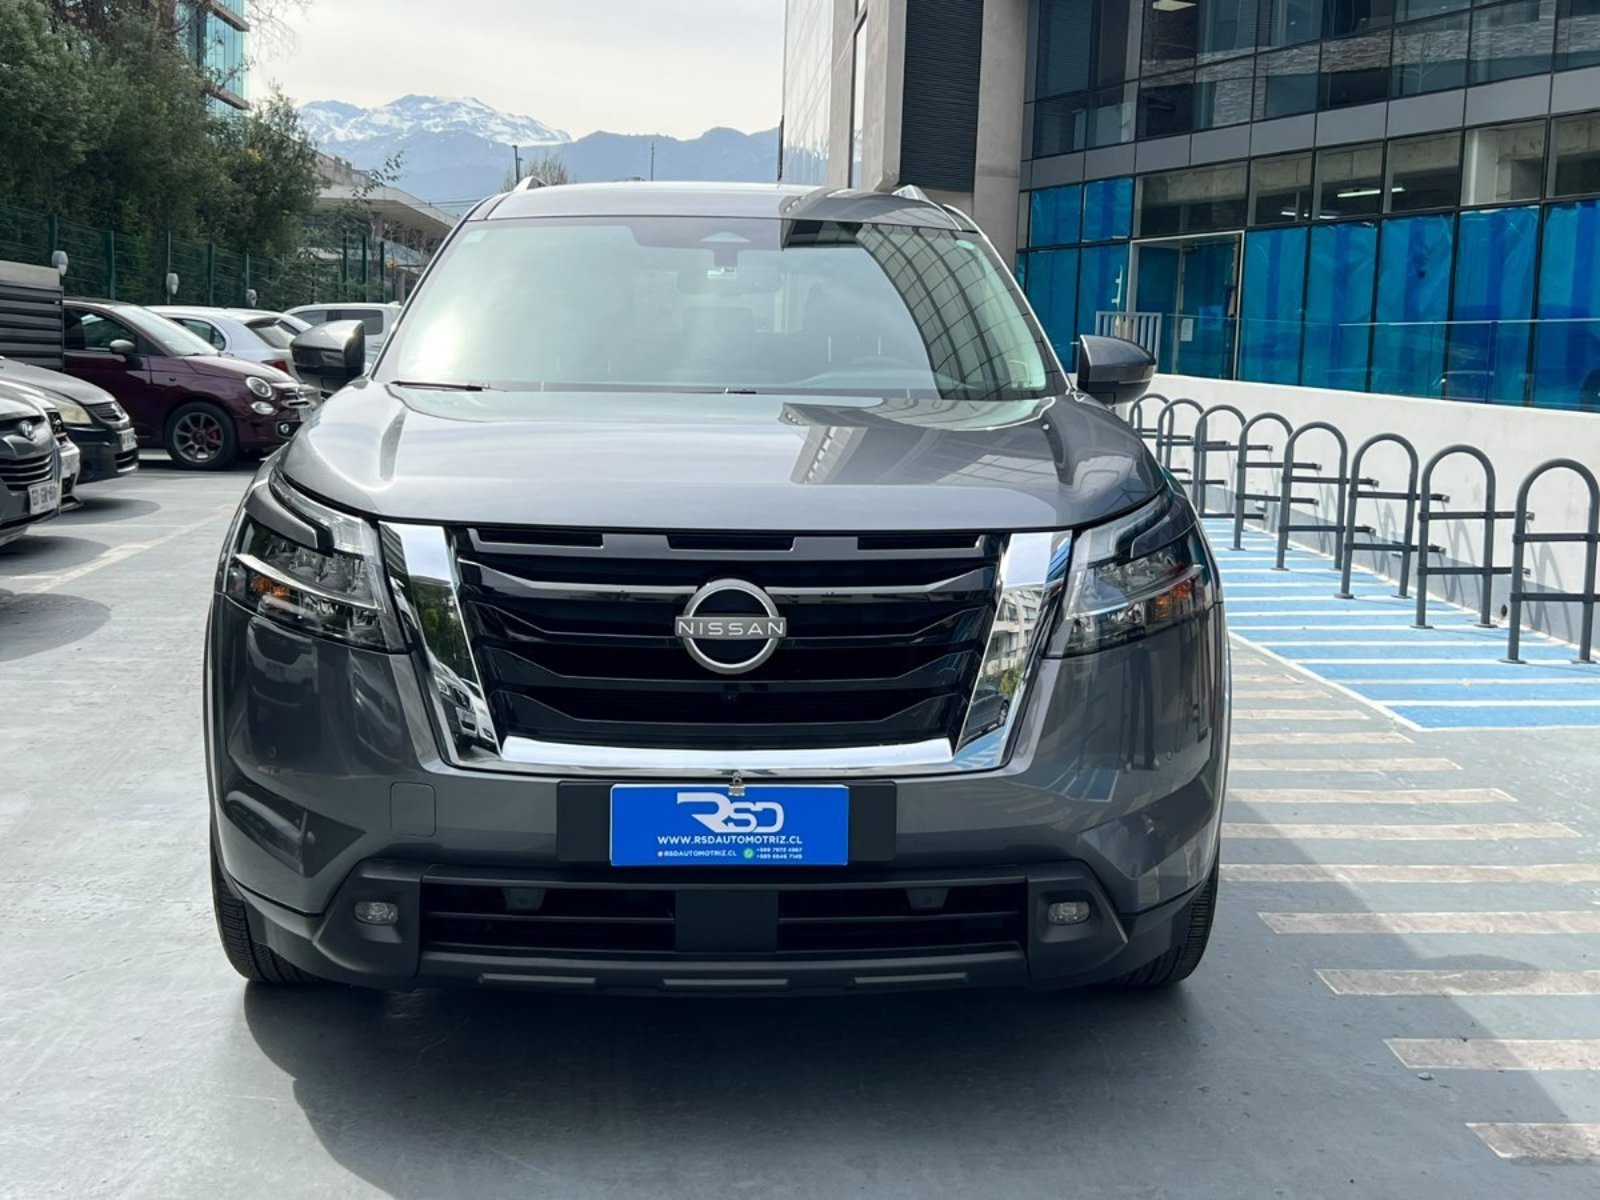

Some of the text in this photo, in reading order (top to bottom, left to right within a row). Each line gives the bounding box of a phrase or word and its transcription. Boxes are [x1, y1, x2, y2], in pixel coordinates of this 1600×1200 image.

[678, 621, 784, 636] NISSAN
[676, 791, 785, 833] RSD
[656, 835, 803, 845] WWW.RSDAUTOMOTRIZ.CL
